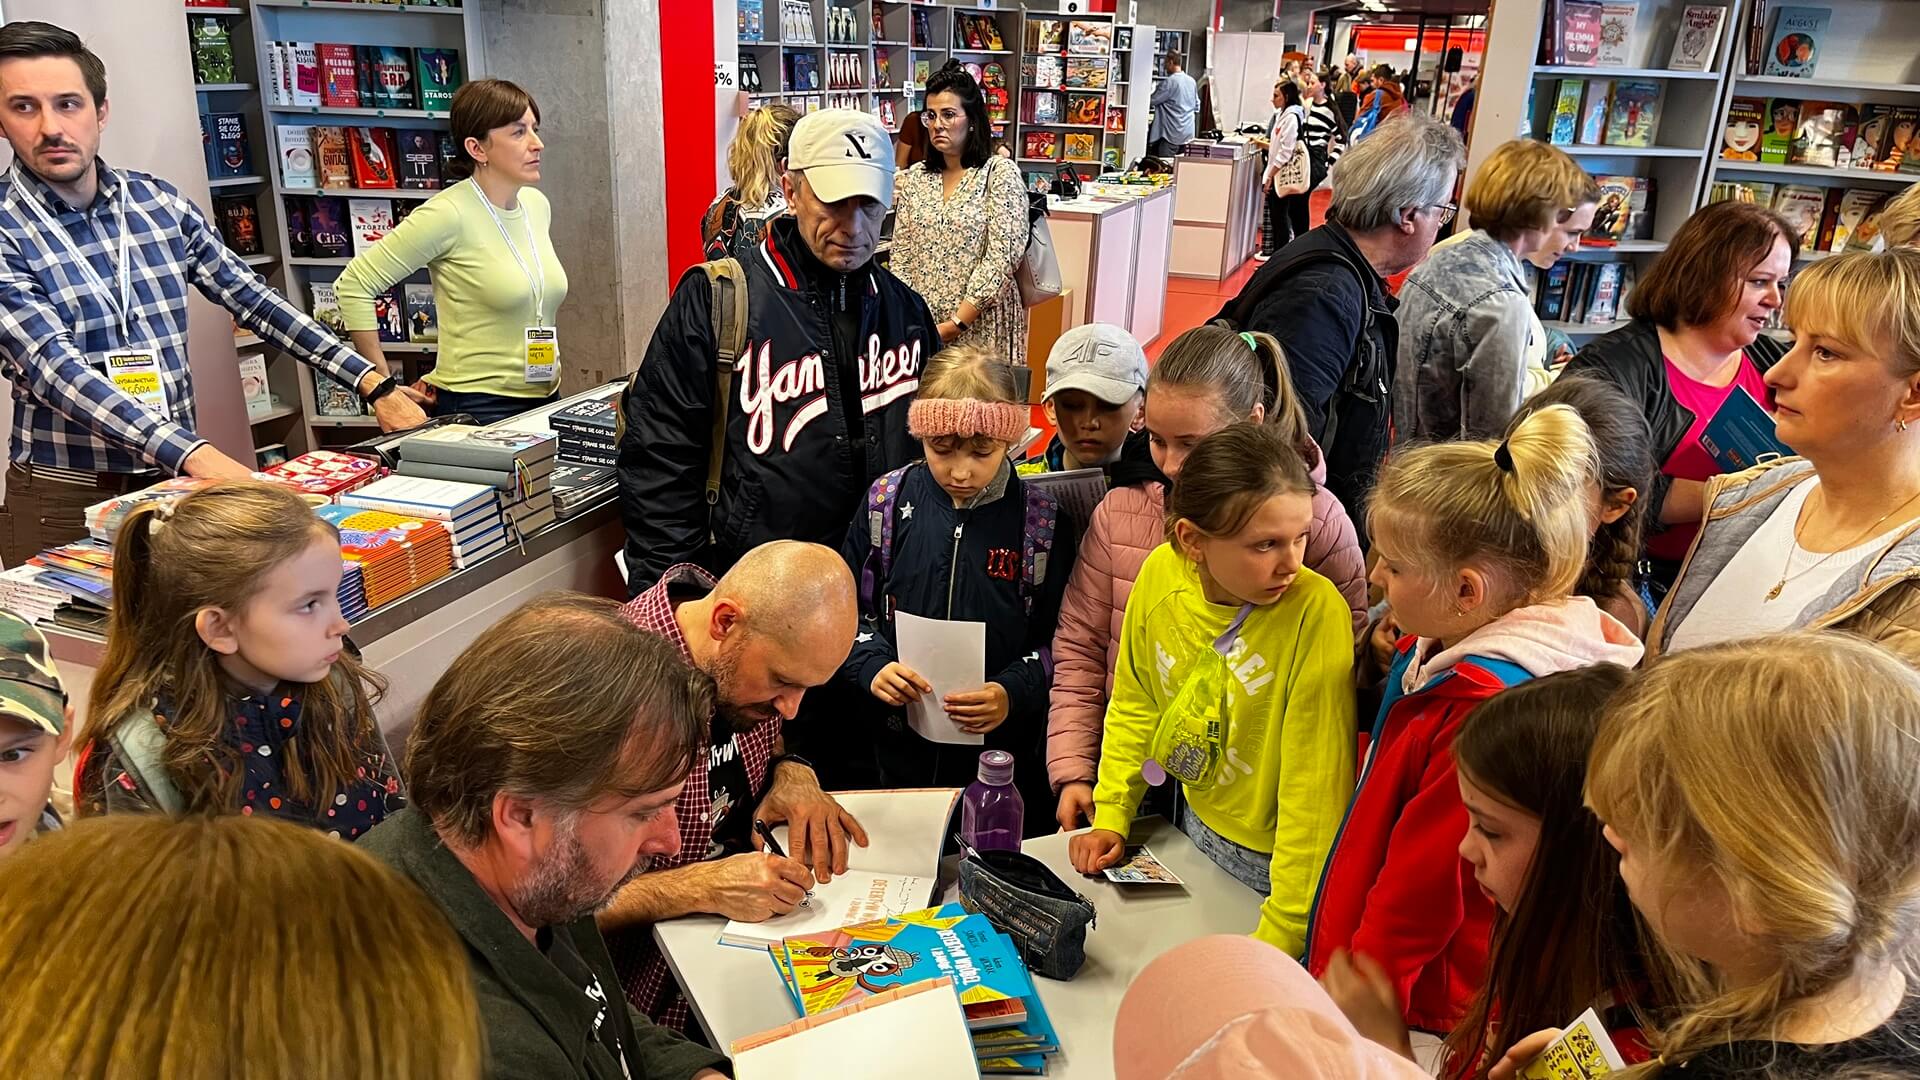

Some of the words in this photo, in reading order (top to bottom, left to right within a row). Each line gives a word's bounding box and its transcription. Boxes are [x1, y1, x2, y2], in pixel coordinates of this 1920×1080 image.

[381, 73, 406, 86] GRA
[218, 117, 239, 125] STANIE
[1728, 110, 1761, 120] mieniny
[1543, 1045, 1564, 1062] DEPTU
[1549, 1053, 1568, 1071] DEPTU
